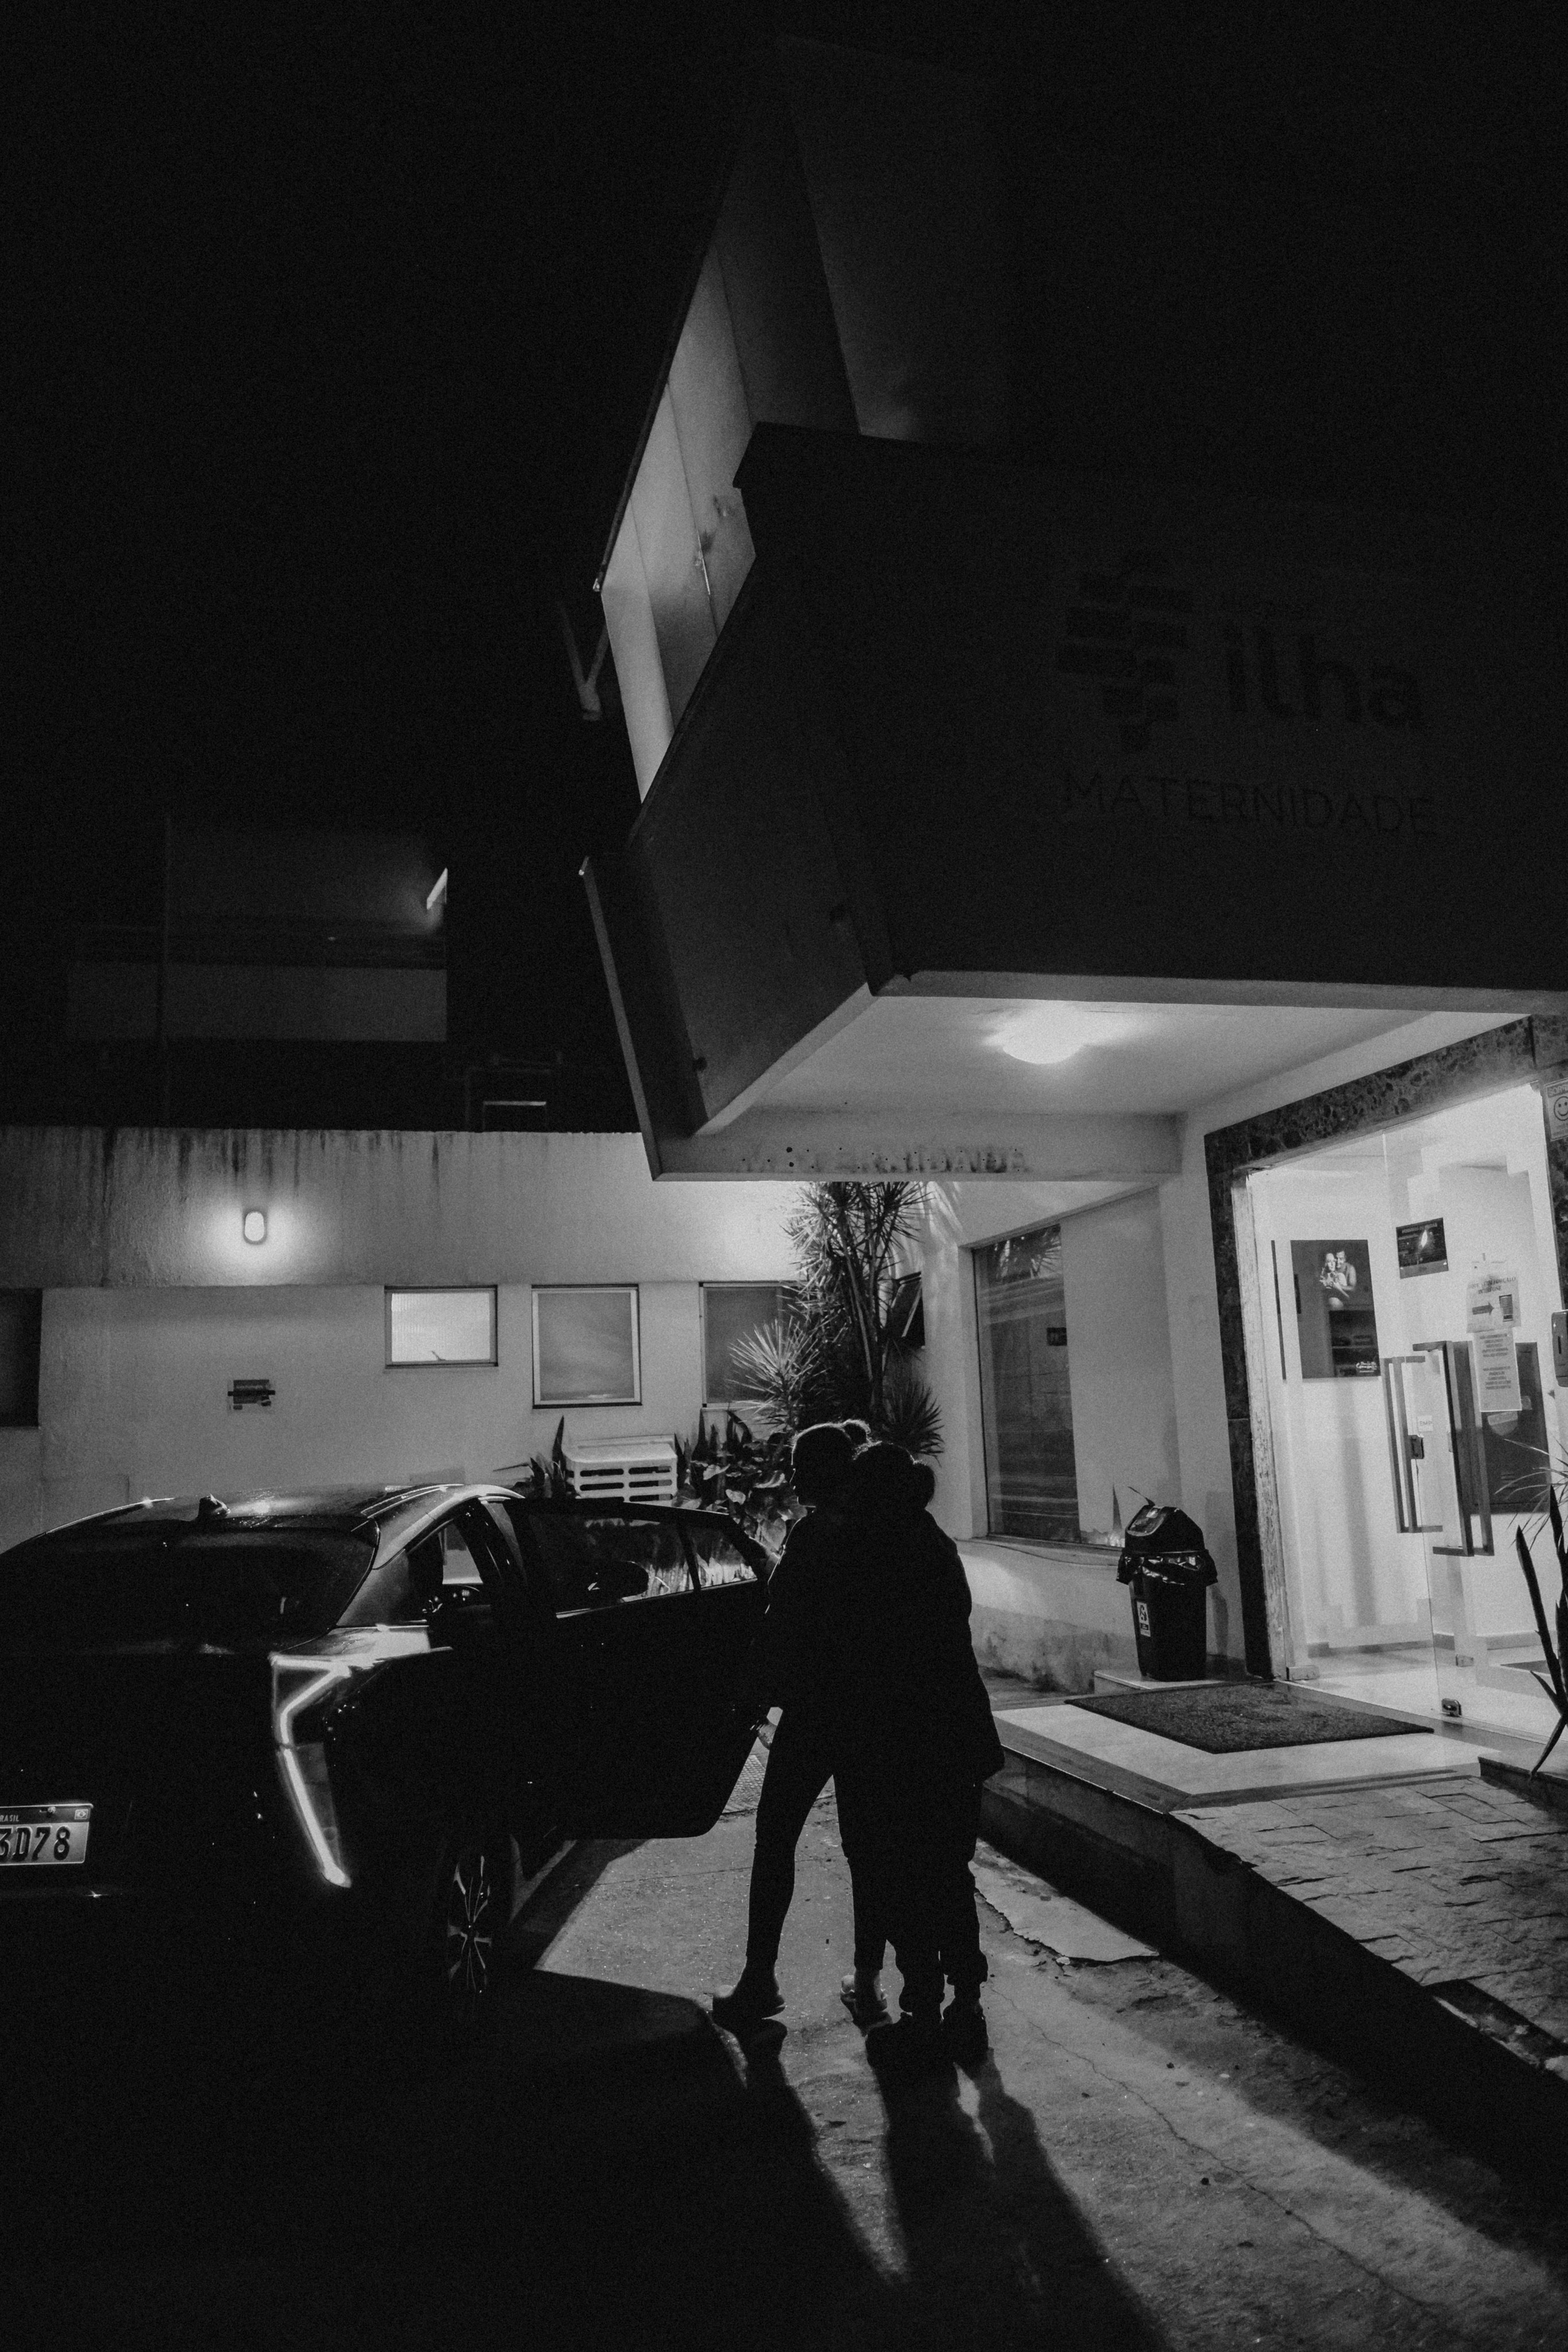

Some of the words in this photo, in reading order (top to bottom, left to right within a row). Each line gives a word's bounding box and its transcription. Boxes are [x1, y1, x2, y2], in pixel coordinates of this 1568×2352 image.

[1222, 621, 1424, 730] ilha
[1061, 769, 1438, 837] MATERNIDADE
[0, 1826, 70, 1861] 3D78
